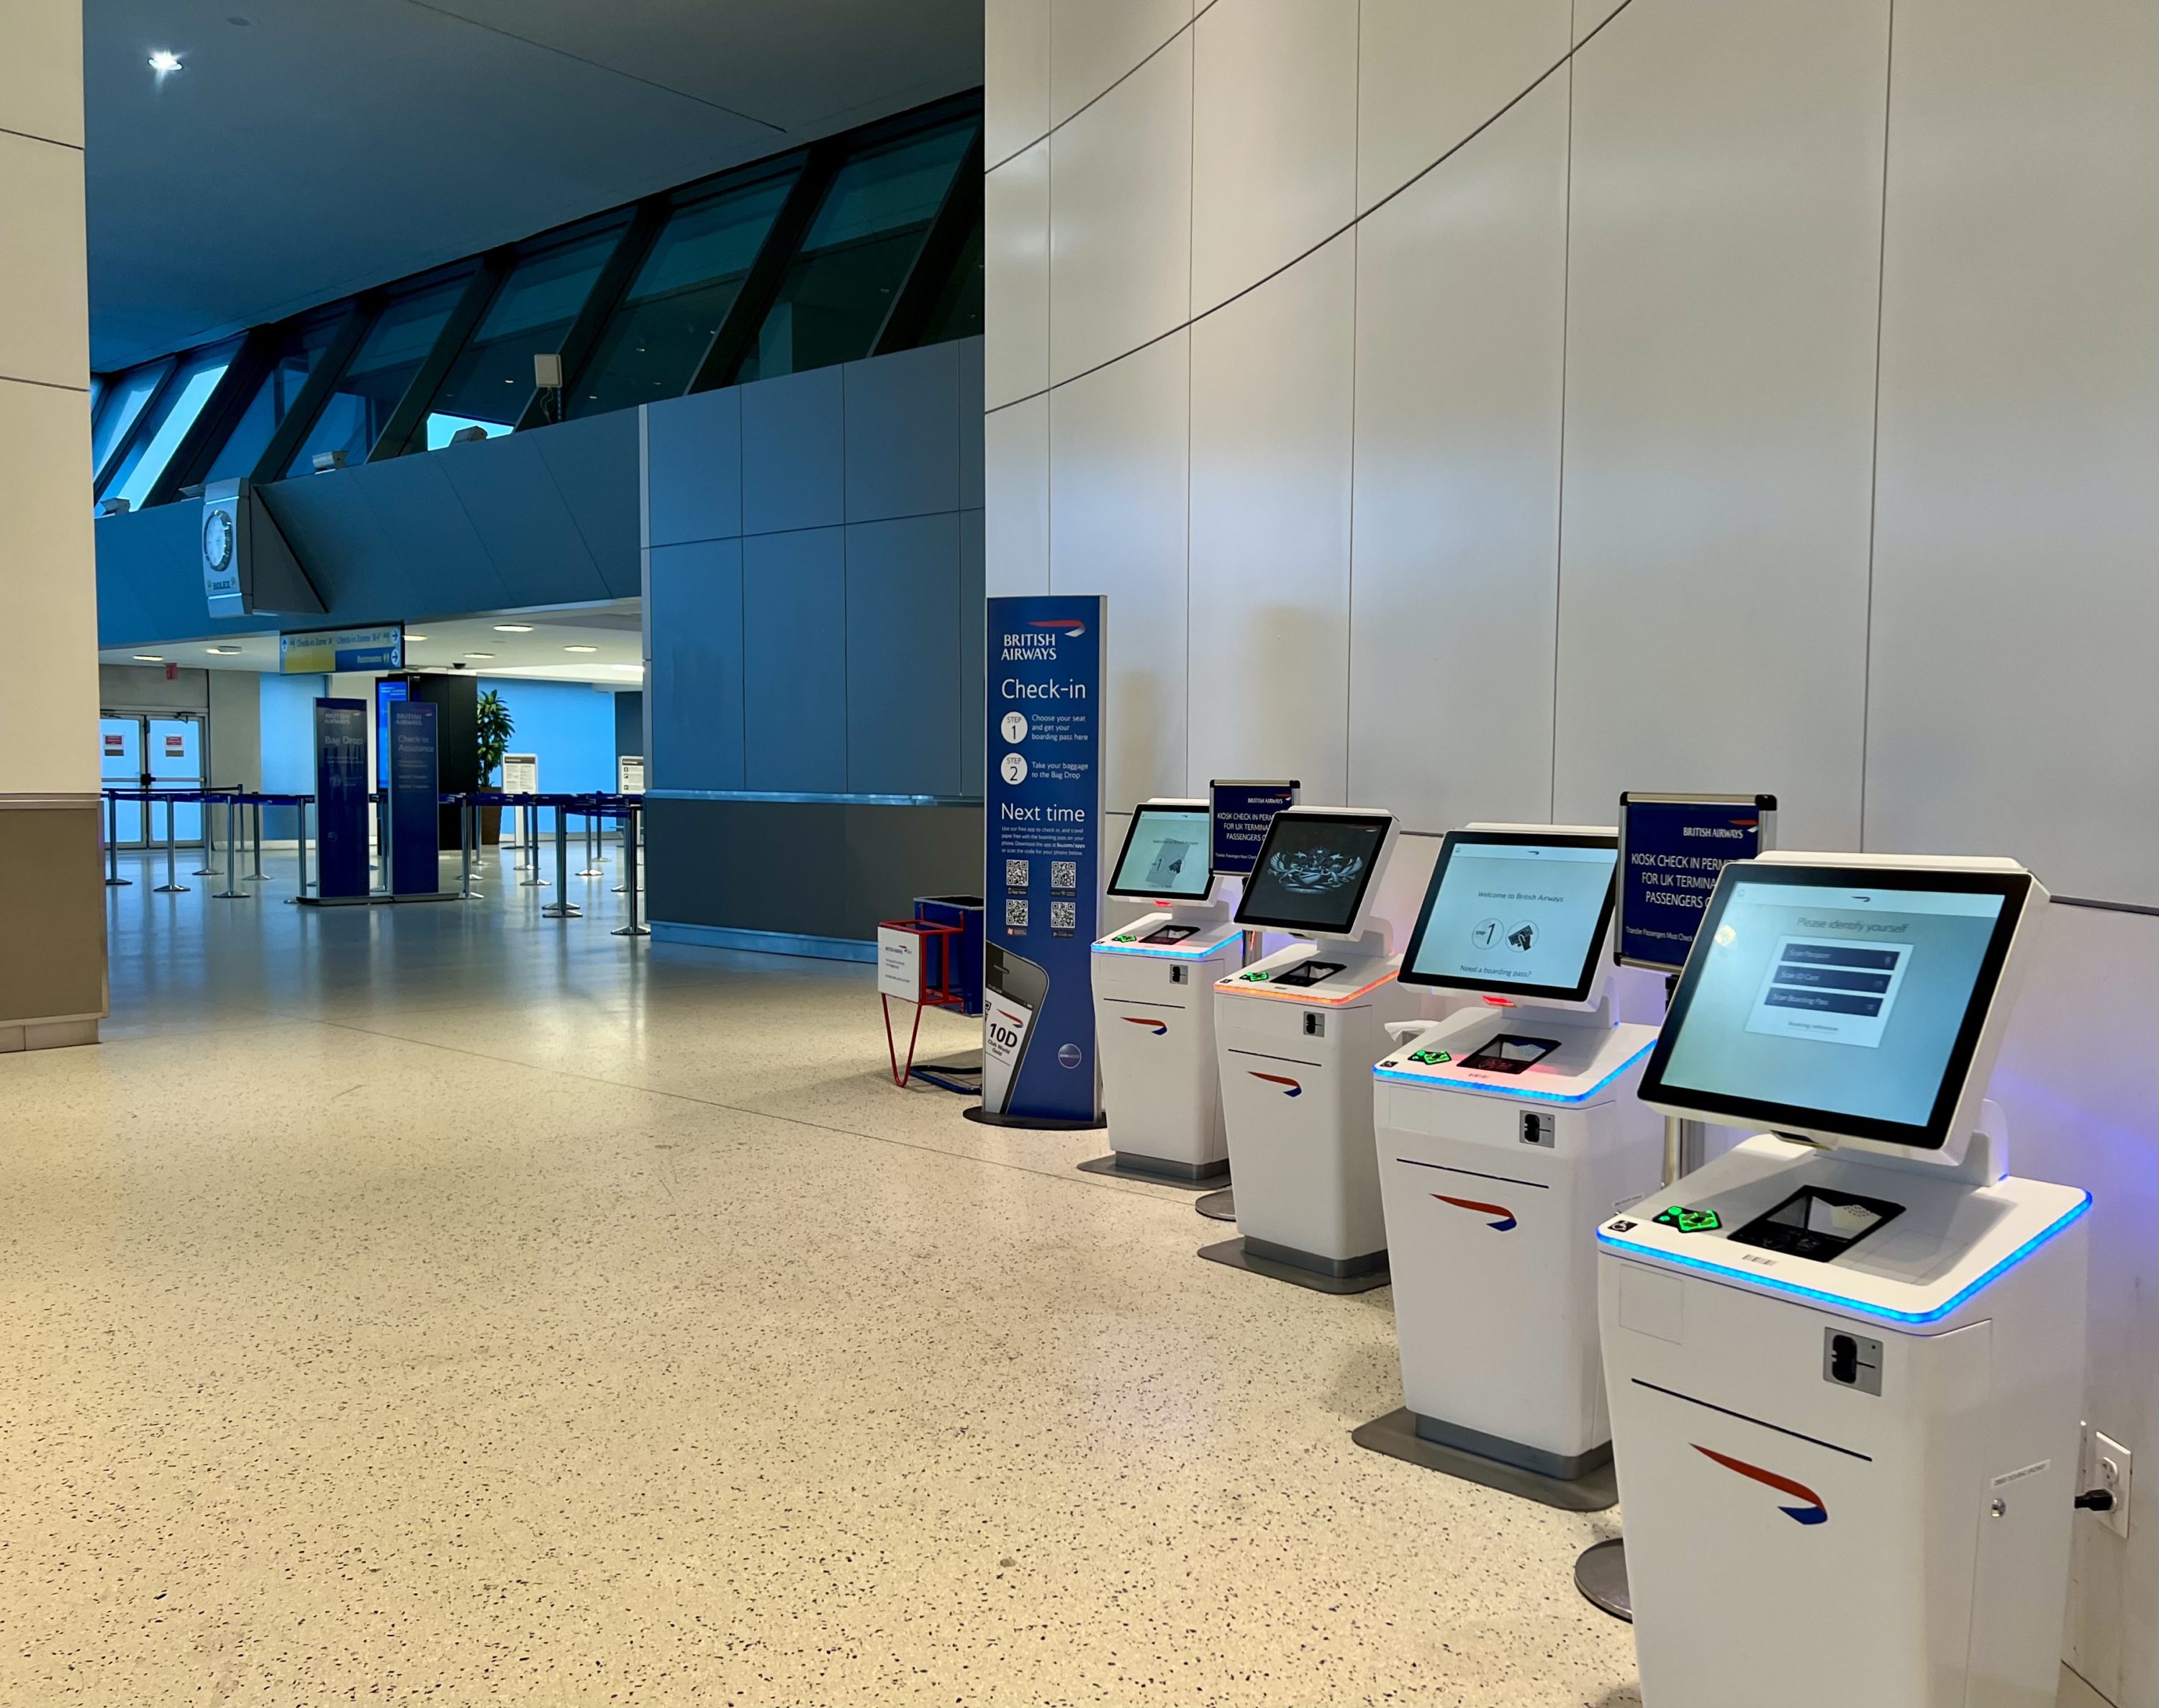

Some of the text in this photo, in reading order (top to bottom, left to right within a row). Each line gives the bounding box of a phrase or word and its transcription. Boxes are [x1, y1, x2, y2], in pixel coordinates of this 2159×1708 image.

[212, 580, 231, 590] ROLEX
[1003, 634, 1056, 646] BRITISH
[1001, 648, 1057, 660] AIRWAYS
[1001, 679, 1086, 699] Check-in
[1011, 725, 1016, 740] 1
[325, 736, 363, 746] Bag Drop
[1010, 766, 1018, 781] 2
[1062, 762, 1088, 771] baggage
[1051, 771, 1063, 780] Bag
[1001, 803, 1085, 822] Next time
[1226, 833, 1261, 841] PASSENGERS
[1683, 827, 1744, 839] BRITISH AIRWAYS
[1631, 853, 1727, 870] KIOSK CHECK IN PERM
[1642, 872, 1717, 890] FOR UK TERMINA
[1645, 891, 1703, 908] PASSENGERS
[1797, 917, 1910, 934] Please identify yourself
[1487, 923, 1495, 944] 1
[1483, 967, 1511, 977] boarding
[990, 1023, 1018, 1048] 10D
